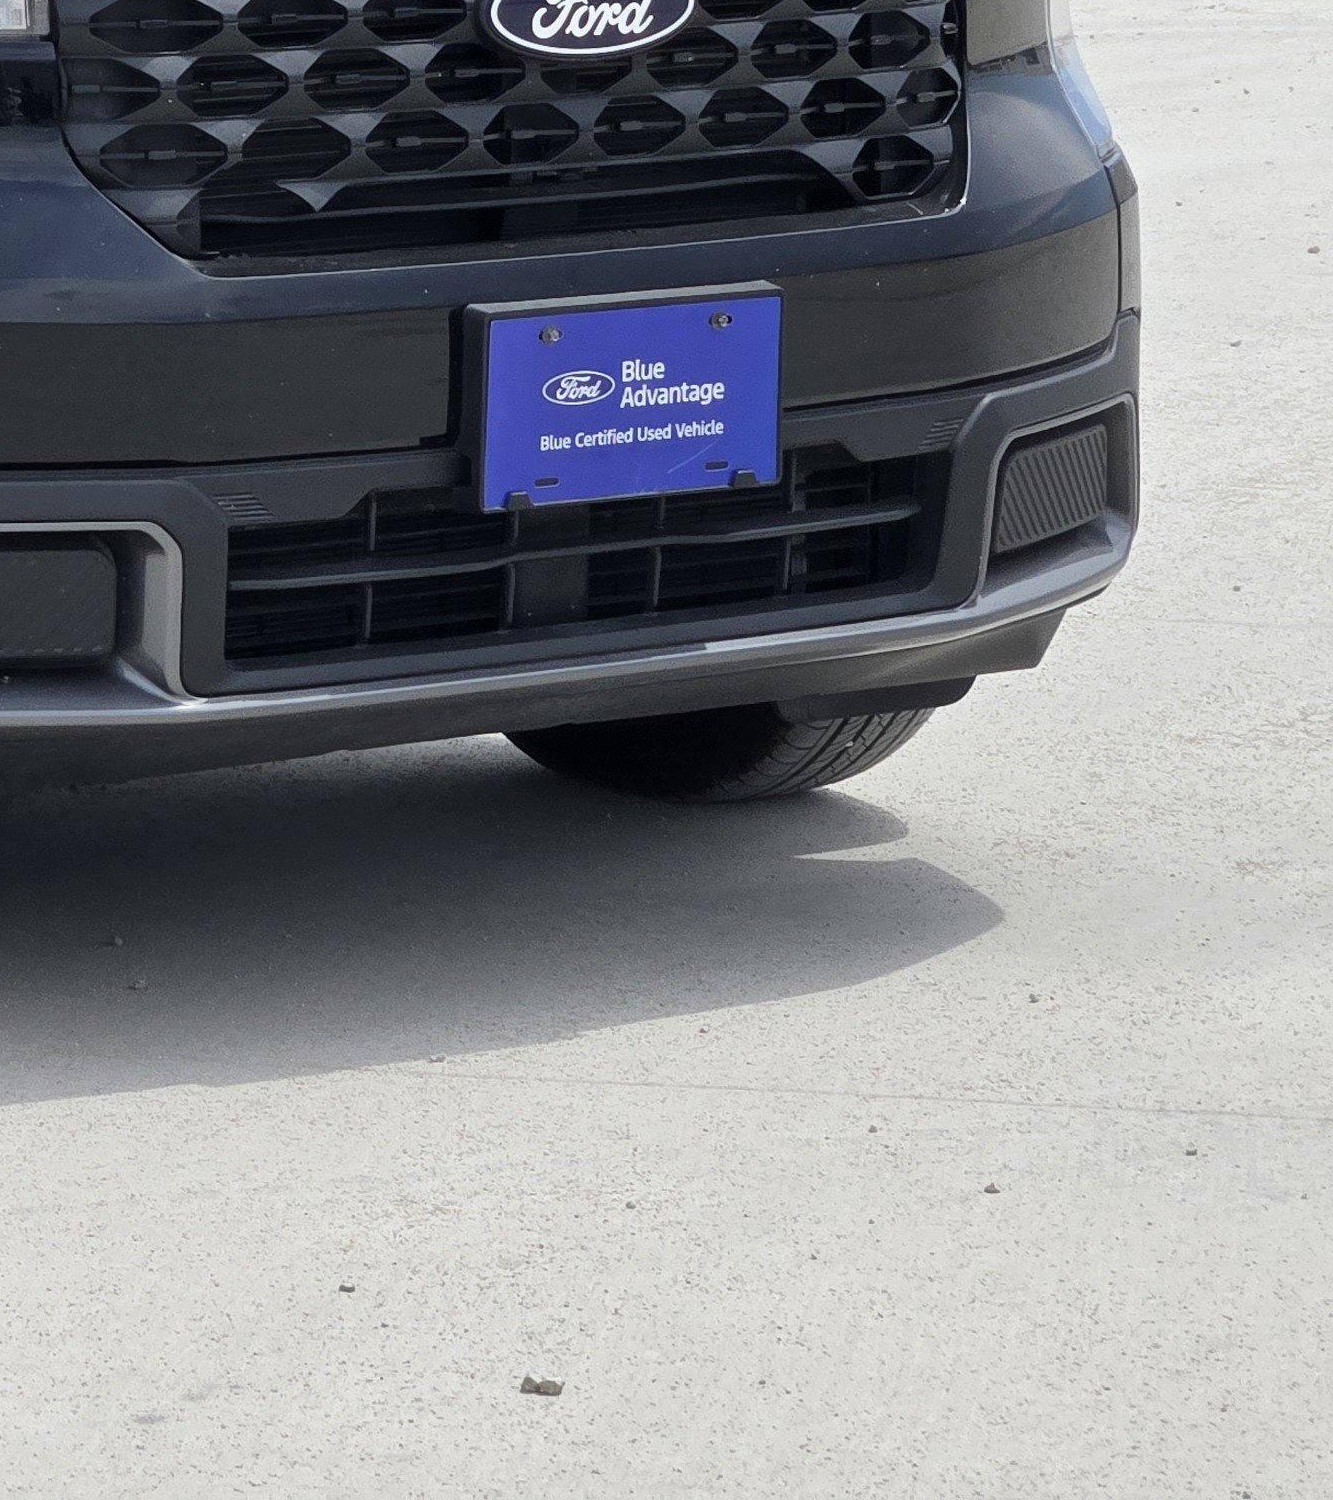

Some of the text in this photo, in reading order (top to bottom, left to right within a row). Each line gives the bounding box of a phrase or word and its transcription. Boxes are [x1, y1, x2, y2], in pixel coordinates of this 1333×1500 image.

[622, 359, 665, 382] Blue
[556, 376, 601, 400] Ford
[620, 382, 725, 408] Advantage
[540, 420, 724, 451] Blue Certified Used Vehicle
